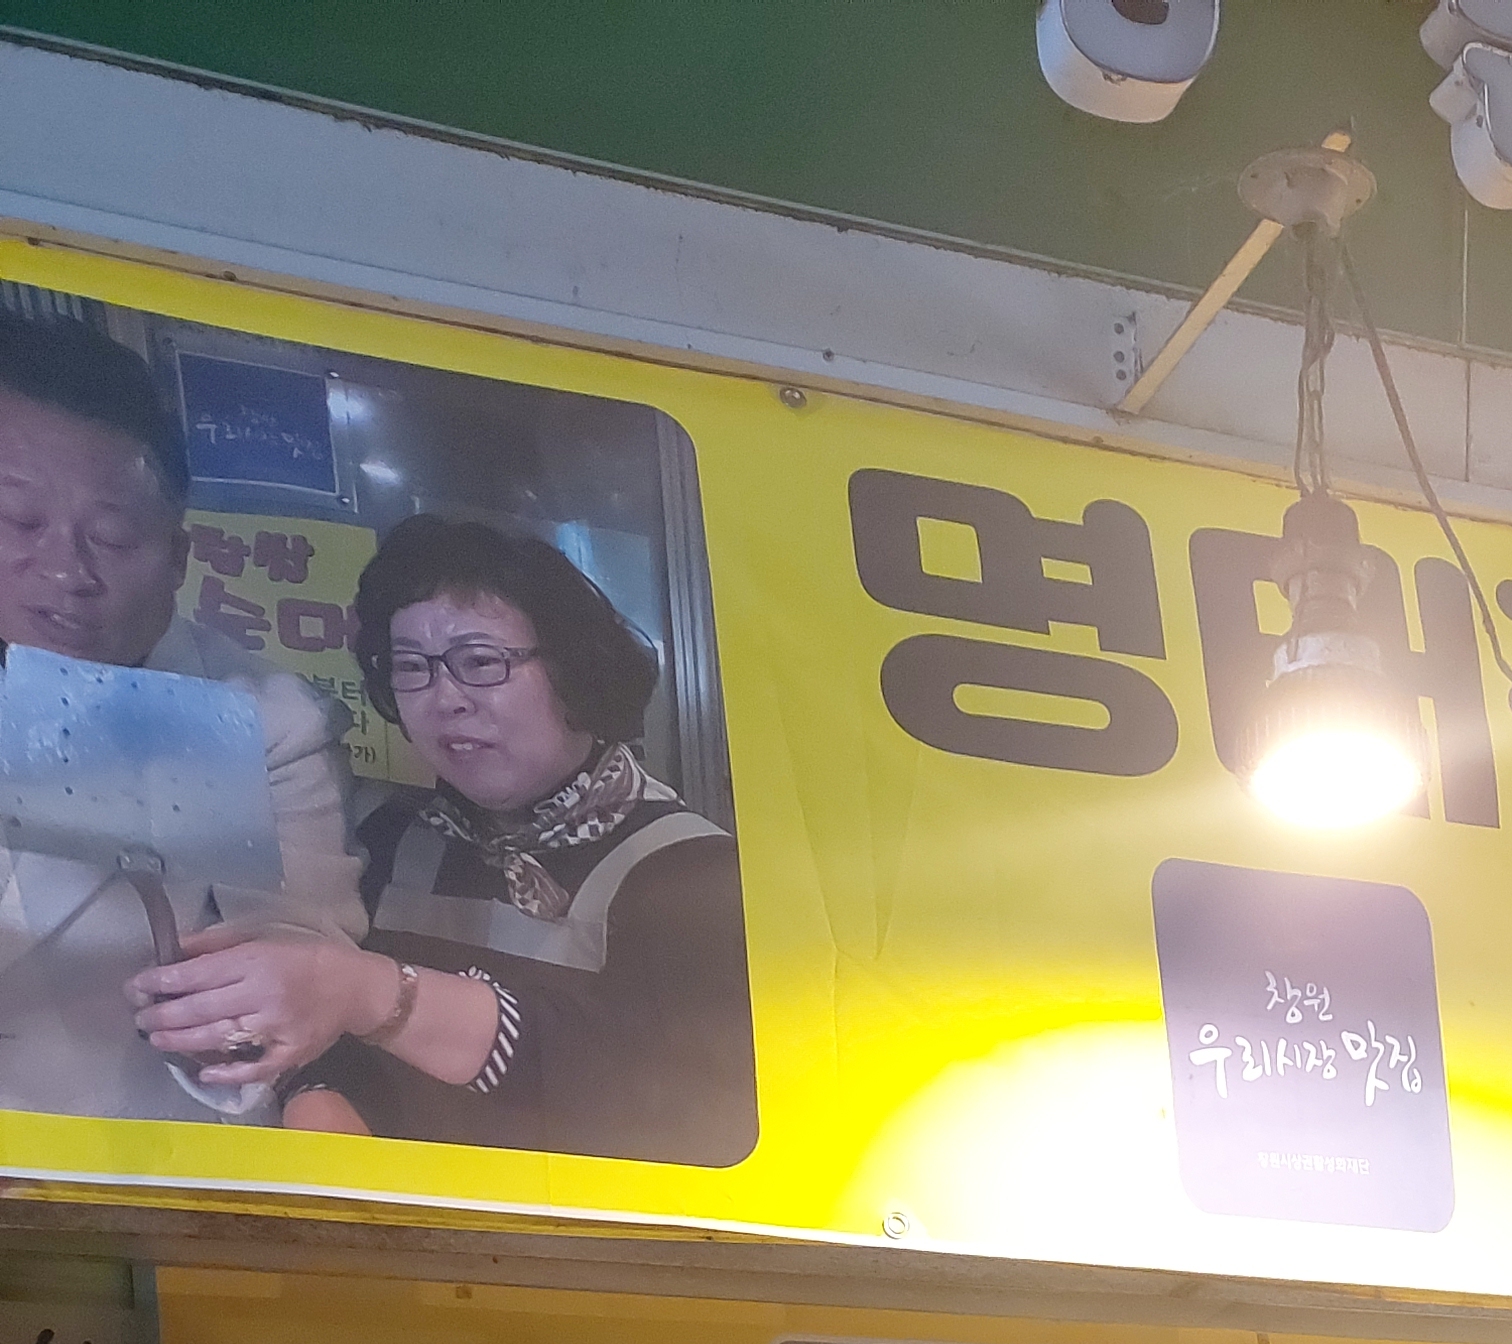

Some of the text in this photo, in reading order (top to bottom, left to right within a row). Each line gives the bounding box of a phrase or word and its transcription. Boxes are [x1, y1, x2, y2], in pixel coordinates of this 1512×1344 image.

[1265, 970, 1333, 1023] 창원
[1189, 1020, 1422, 1107] 우리시장 맛집
